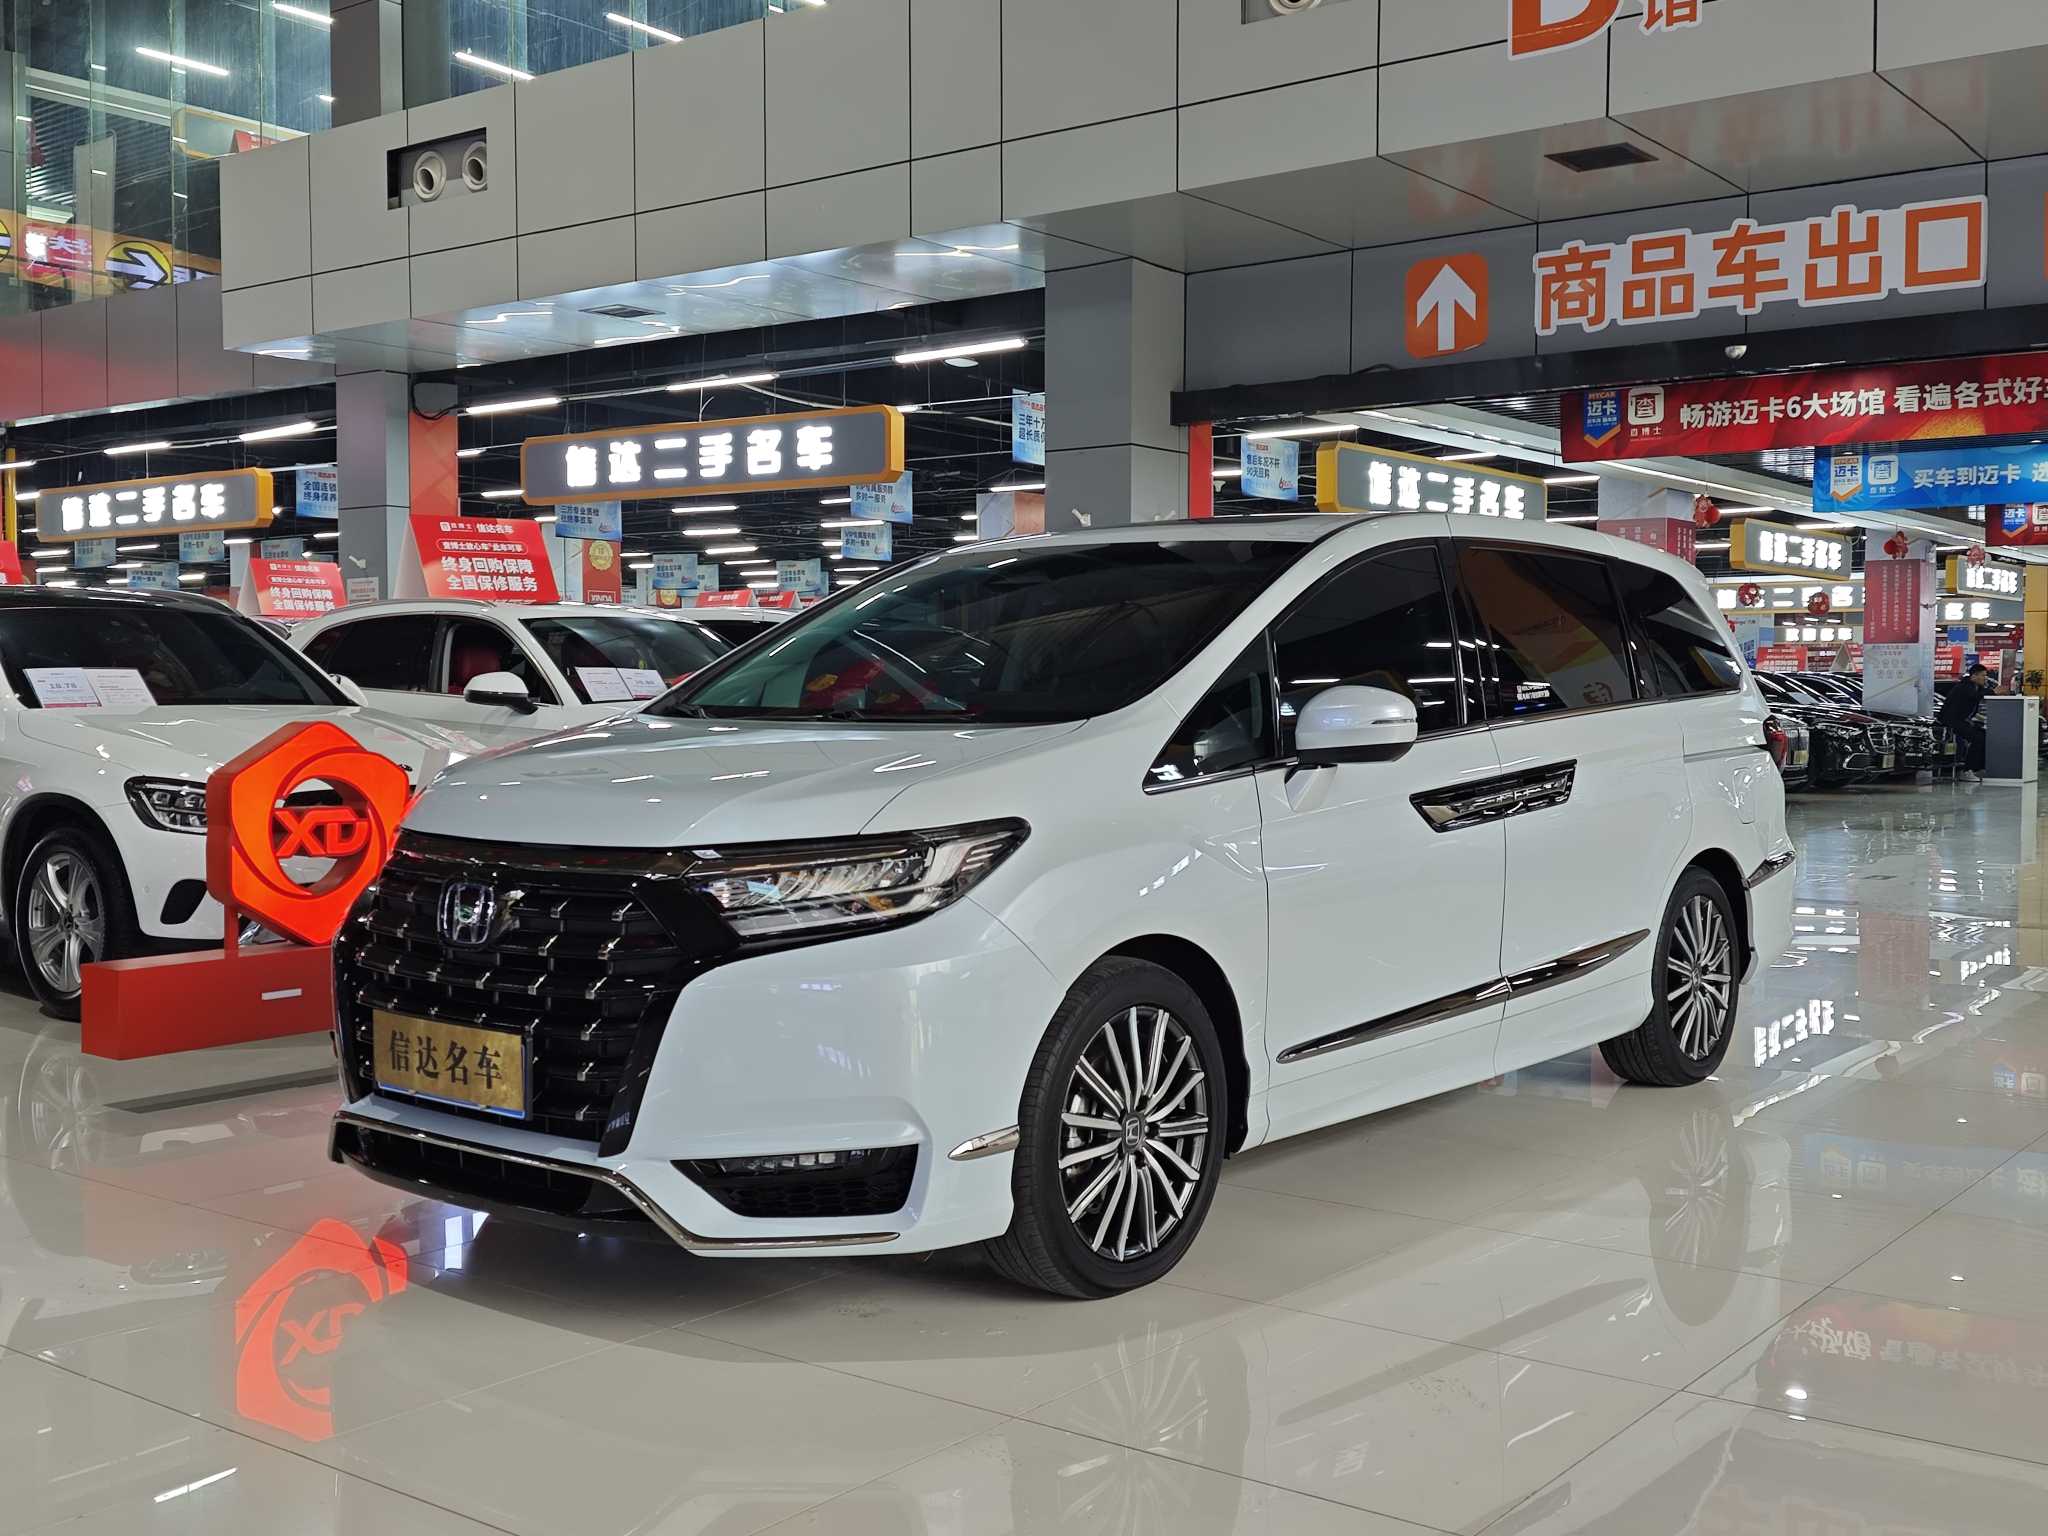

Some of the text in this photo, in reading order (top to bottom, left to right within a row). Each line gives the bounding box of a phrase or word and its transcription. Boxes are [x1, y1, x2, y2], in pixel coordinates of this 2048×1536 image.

[1536, 201, 1983, 331] 商品车出口
[1587, 399, 1617, 417] 迈卡
[1679, 376, 2048, 430] 畅游迈卡6大场馆 看遍各式好
[1913, 463, 2021, 488] 买车到迈卡
[440, 555, 535, 575] 终身回购保障
[446, 574, 538, 593] 全国保修服务
[389, 1029, 502, 1090] 信达名车
